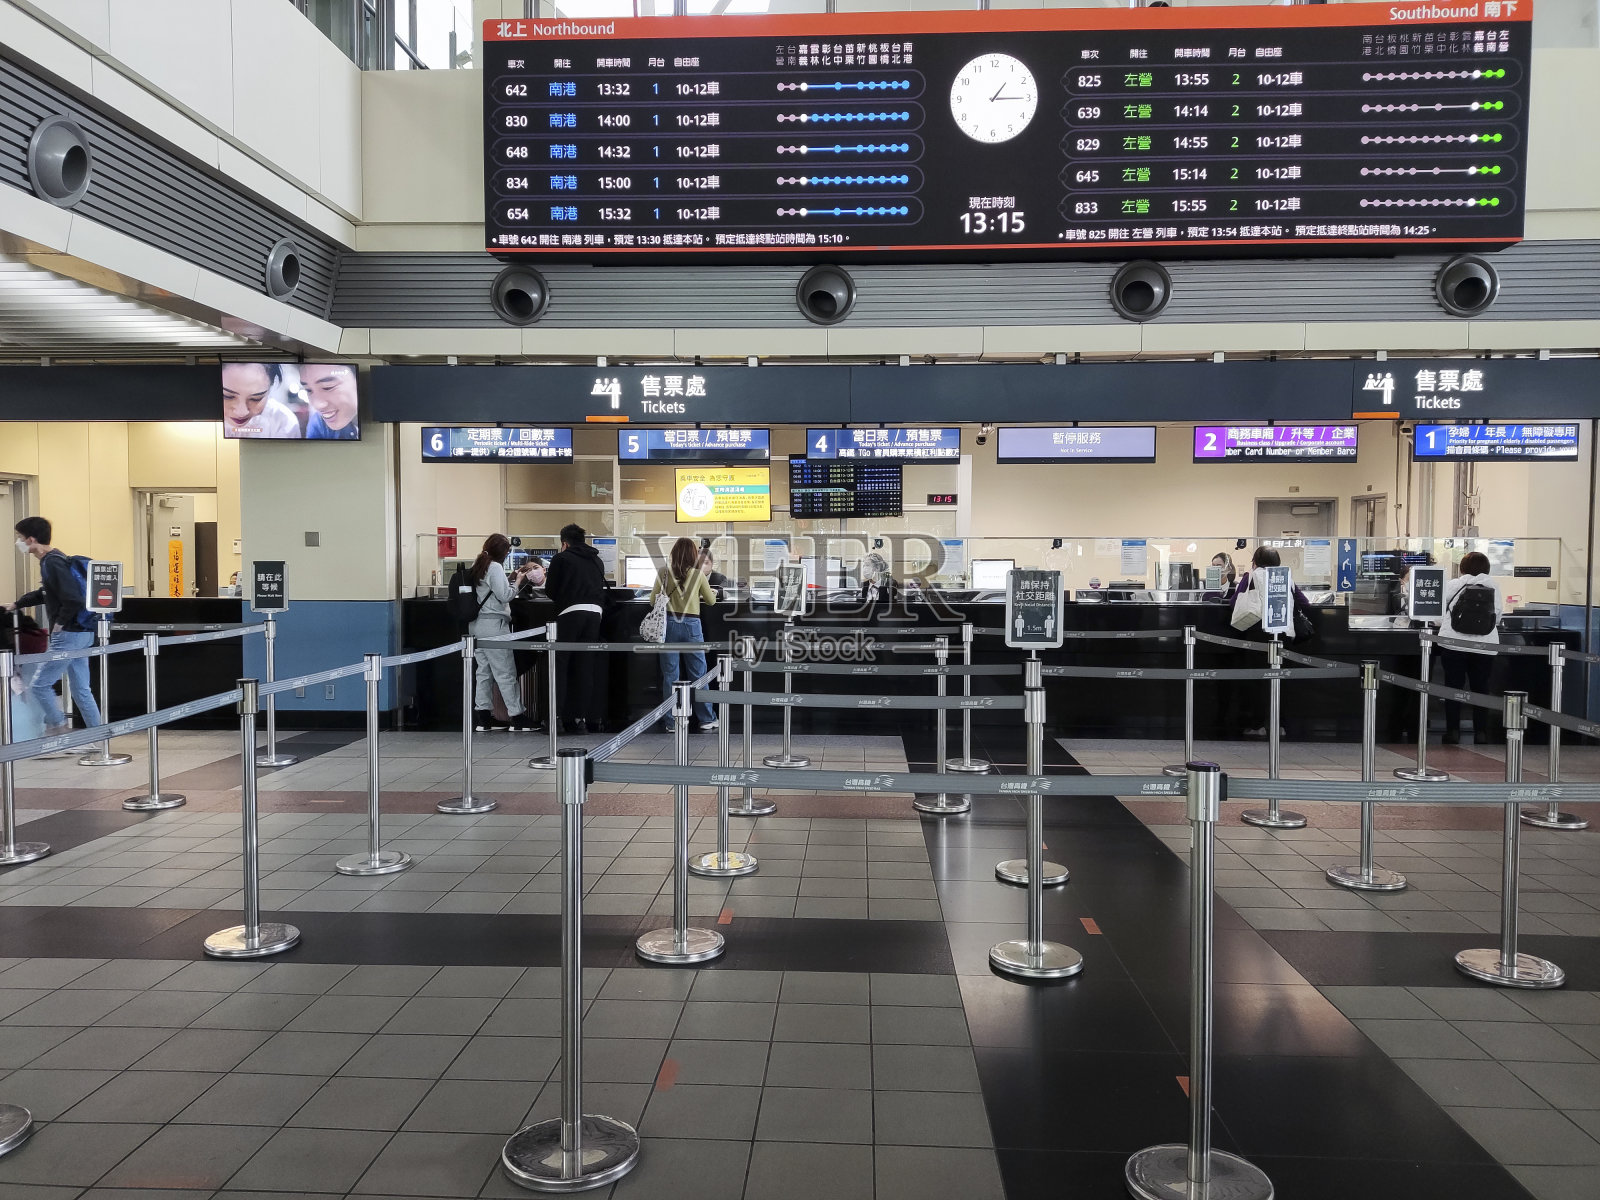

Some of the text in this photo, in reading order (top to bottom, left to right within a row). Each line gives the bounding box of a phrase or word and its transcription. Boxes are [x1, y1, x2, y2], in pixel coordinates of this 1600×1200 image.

[1390, 0, 1518, 20] Southbound 南下
[496, 21, 614, 37] 北上 Northbound
[1081, 48, 1282, 59] 車次 開往 開車時間 月台 自由座
[508, 57, 699, 68] 車次 開往 開車時間 月台 自由座
[991, 60, 999, 68] 12
[974, 65, 982, 73] 11
[961, 78, 970, 86] 10
[1078, 72, 1303, 87] 825 左營 13:55 2 10-12車
[506, 81, 719, 96] 642 南港 13:32 1 10-12車
[1026, 94, 1031, 102] 3
[1078, 103, 1302, 118] 639 左營 14:14 2 10-12車
[506, 112, 719, 127] 830 南港 14:00 1 10-12車
[961, 113, 967, 121] 8
[973, 125, 978, 133] 7
[990, 129, 995, 137] 6
[1008, 124, 1013, 132] 5
[1077, 134, 1302, 150] 829 左營 14:55 2 10-12車
[506, 144, 720, 158] 648 南港 14:32 1 10-12車
[1076, 166, 1301, 182] 645 左營 15:14 2 10-12車
[507, 175, 720, 190] 834 南港 15:00 1 10-12車
[969, 196, 1015, 209] 現在時刻
[1075, 197, 1300, 214] 833 左營 15:55 2 10-12車
[507, 206, 720, 220] 654 南港 15:32 1 10-12車
[960, 212, 1025, 233] 13:15
[499, 234, 519, 245] 車號
[521, 236, 537, 244] 642
[540, 234, 559, 245] 開往
[562, 234, 582, 245] 南港
[637, 236, 661, 244] 13:30
[1066, 229, 1086, 240] 車號
[1089, 230, 1106, 239] 825
[1109, 228, 1129, 239] 開往
[1132, 228, 1153, 238] 左營
[1212, 228, 1237, 236] 13:54
[641, 375, 706, 398] 售票處
[1415, 369, 1484, 392] 售票處
[641, 400, 686, 414] Tickets
[1414, 396, 1461, 409] Tickets
[468, 428, 554, 440] 定期票 回數票
[664, 430, 752, 442] 當日票 預售票
[853, 430, 942, 441] 當日票 預售票
[1053, 432, 1102, 444] 暫停服務
[1228, 428, 1355, 440] 商務車廂 升等 企業
[1448, 427, 1575, 438] 孕婦 年長 無障礙專用
[431, 433, 443, 451] 6
[628, 436, 639, 453] 5
[816, 435, 828, 452] 4
[1203, 433, 1217, 451] 2
[1425, 431, 1435, 449] 1
[1245, 447, 1263, 455] Card
[1266, 447, 1292, 455] Number
[1308, 447, 1334, 455] Member
[257, 573, 282, 582] 請在此
[1416, 579, 1440, 588] 請在此
[262, 583, 278, 591] 等候
[1020, 580, 1050, 590] 請保持
[1016, 591, 1056, 601] 社交距離
[1420, 589, 1435, 597] 等候
